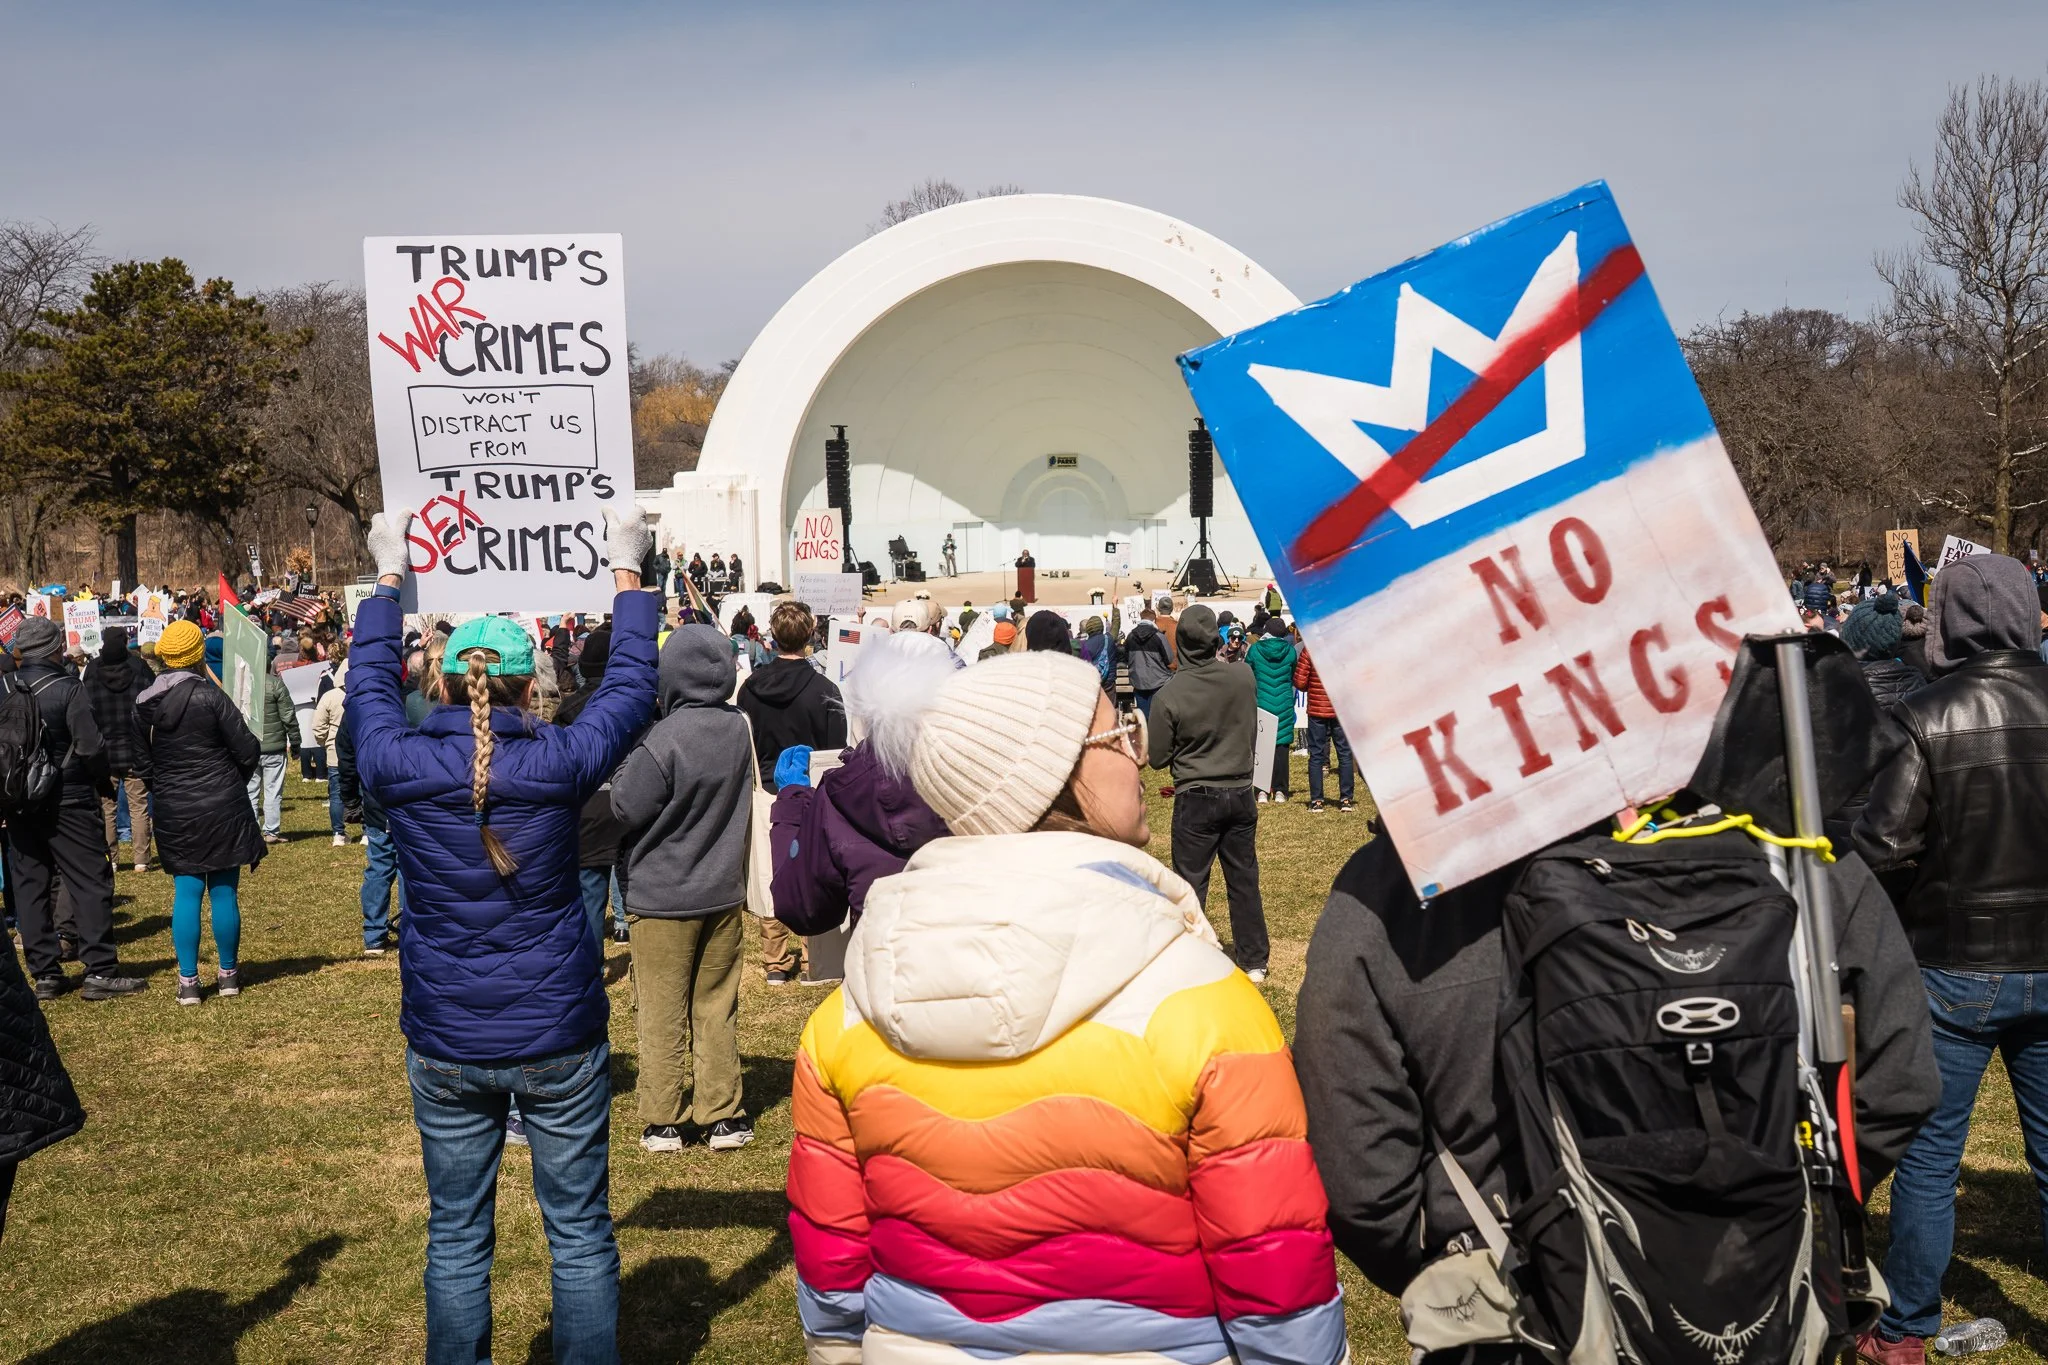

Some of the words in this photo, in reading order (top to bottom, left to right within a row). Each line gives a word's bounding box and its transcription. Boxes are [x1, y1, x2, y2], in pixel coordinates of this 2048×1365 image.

[396, 243, 608, 286] TRUMP'S
[378, 277, 486, 372] WAR
[438, 320, 611, 377] CRIMES
[463, 391, 541, 404] WON'T
[421, 413, 532, 436] DISTRACT
[550, 414, 582, 434] US
[469, 441, 527, 458] FROM
[429, 469, 615, 503] TRUMP'S
[405, 490, 484, 573] SEX
[1892, 532, 1909, 541] NO
[795, 539, 840, 561] KINGS
[1944, 547, 1971, 559] FA
[1956, 539, 1973, 554] NO
[1468, 516, 1614, 647] NO
[1892, 570, 1906, 579] WA
[355, 589, 371, 598] Abu
[0, 616, 22, 637] FASCISM
[66, 615, 98, 625] TRUMP
[1402, 594, 1744, 816] KINGS
